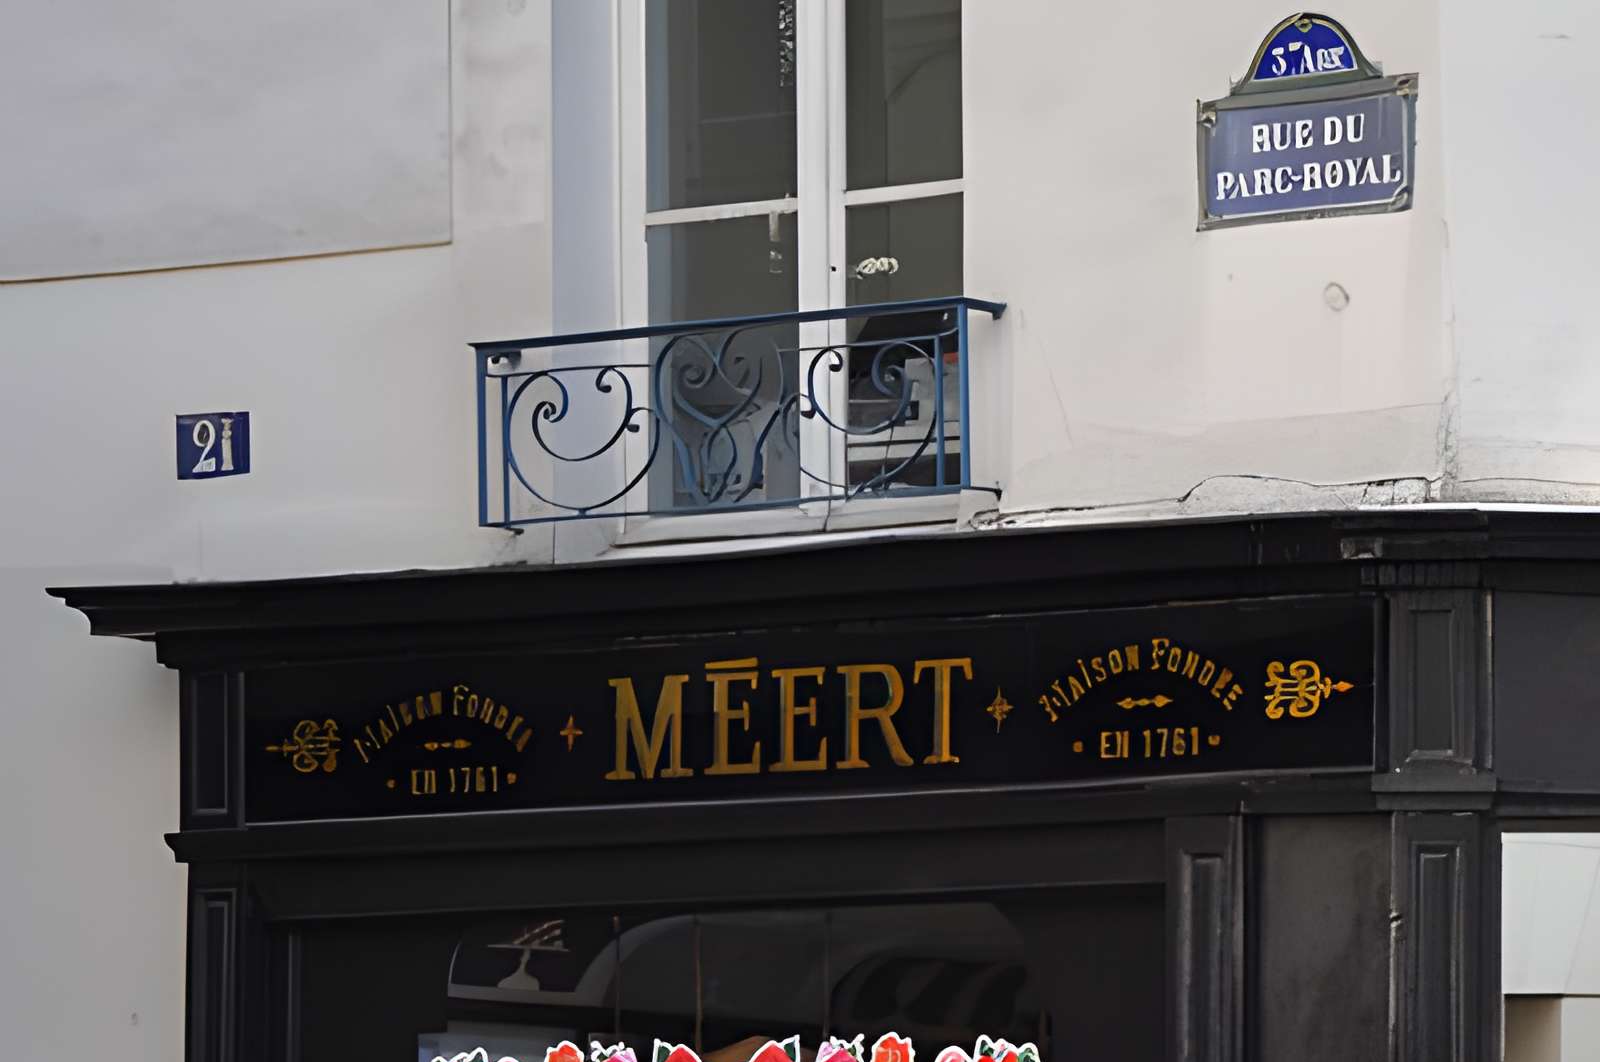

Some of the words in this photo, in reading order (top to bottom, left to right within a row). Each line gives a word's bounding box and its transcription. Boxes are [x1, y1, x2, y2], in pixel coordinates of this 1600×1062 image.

[1252, 120, 1313, 152] RUE
[1323, 113, 1365, 146] DU
[1215, 154, 1401, 200] PARC-ROYAL
[192, 418, 234, 473] 21
[1142, 726, 1200, 759] 1761
